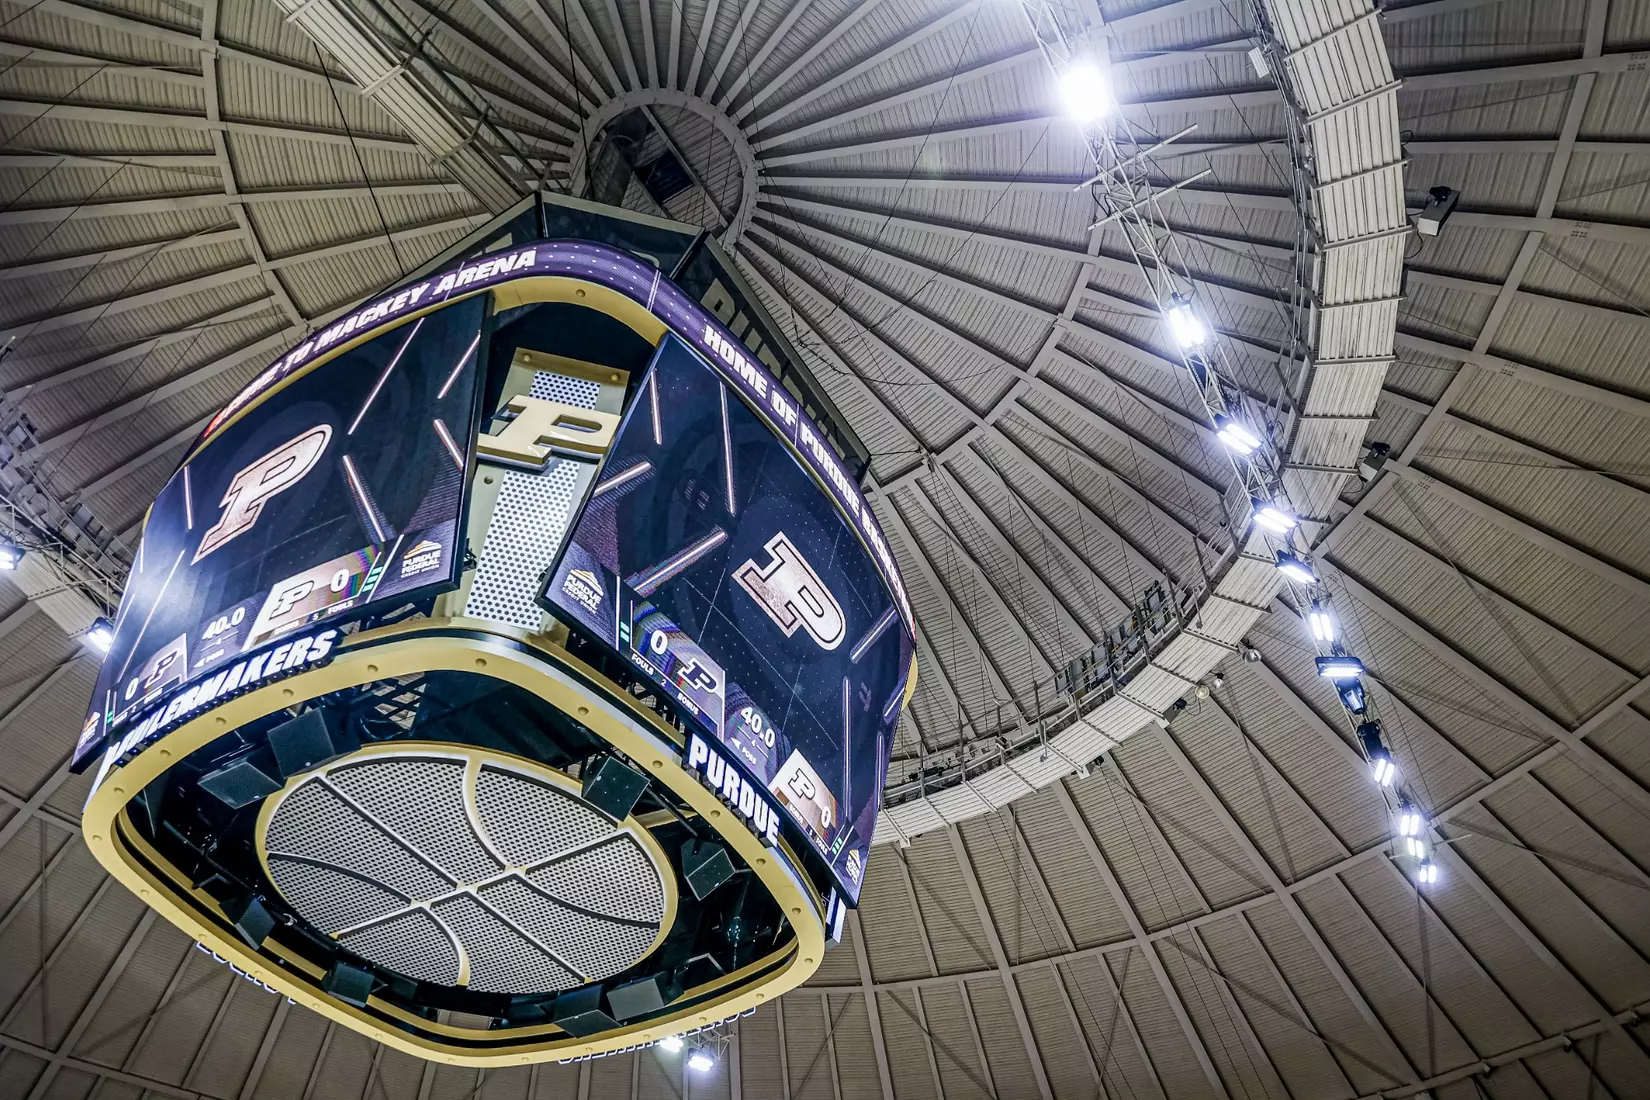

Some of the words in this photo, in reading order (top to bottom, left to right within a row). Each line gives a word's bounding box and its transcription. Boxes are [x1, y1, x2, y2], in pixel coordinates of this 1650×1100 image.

[282, 341, 315, 372] TO
[314, 283, 431, 351] MACKEY
[432, 250, 537, 296] ARENA
[704, 324, 768, 399] HOME
[771, 390, 798, 426] OF
[800, 421, 860, 518] PURDUE
[330, 569, 350, 593] 0
[564, 580, 598, 611] FEDERAL
[567, 574, 602, 604] PURDUE
[202, 607, 246, 640] 40.0
[650, 630, 668, 655] 0
[631, 653, 654, 676] FOULS
[125, 677, 138, 700] 0
[677, 692, 699, 716] BONUS
[741, 706, 776, 749] 40.0
[688, 732, 780, 848] PURDUE
[821, 806, 832, 829] 0
